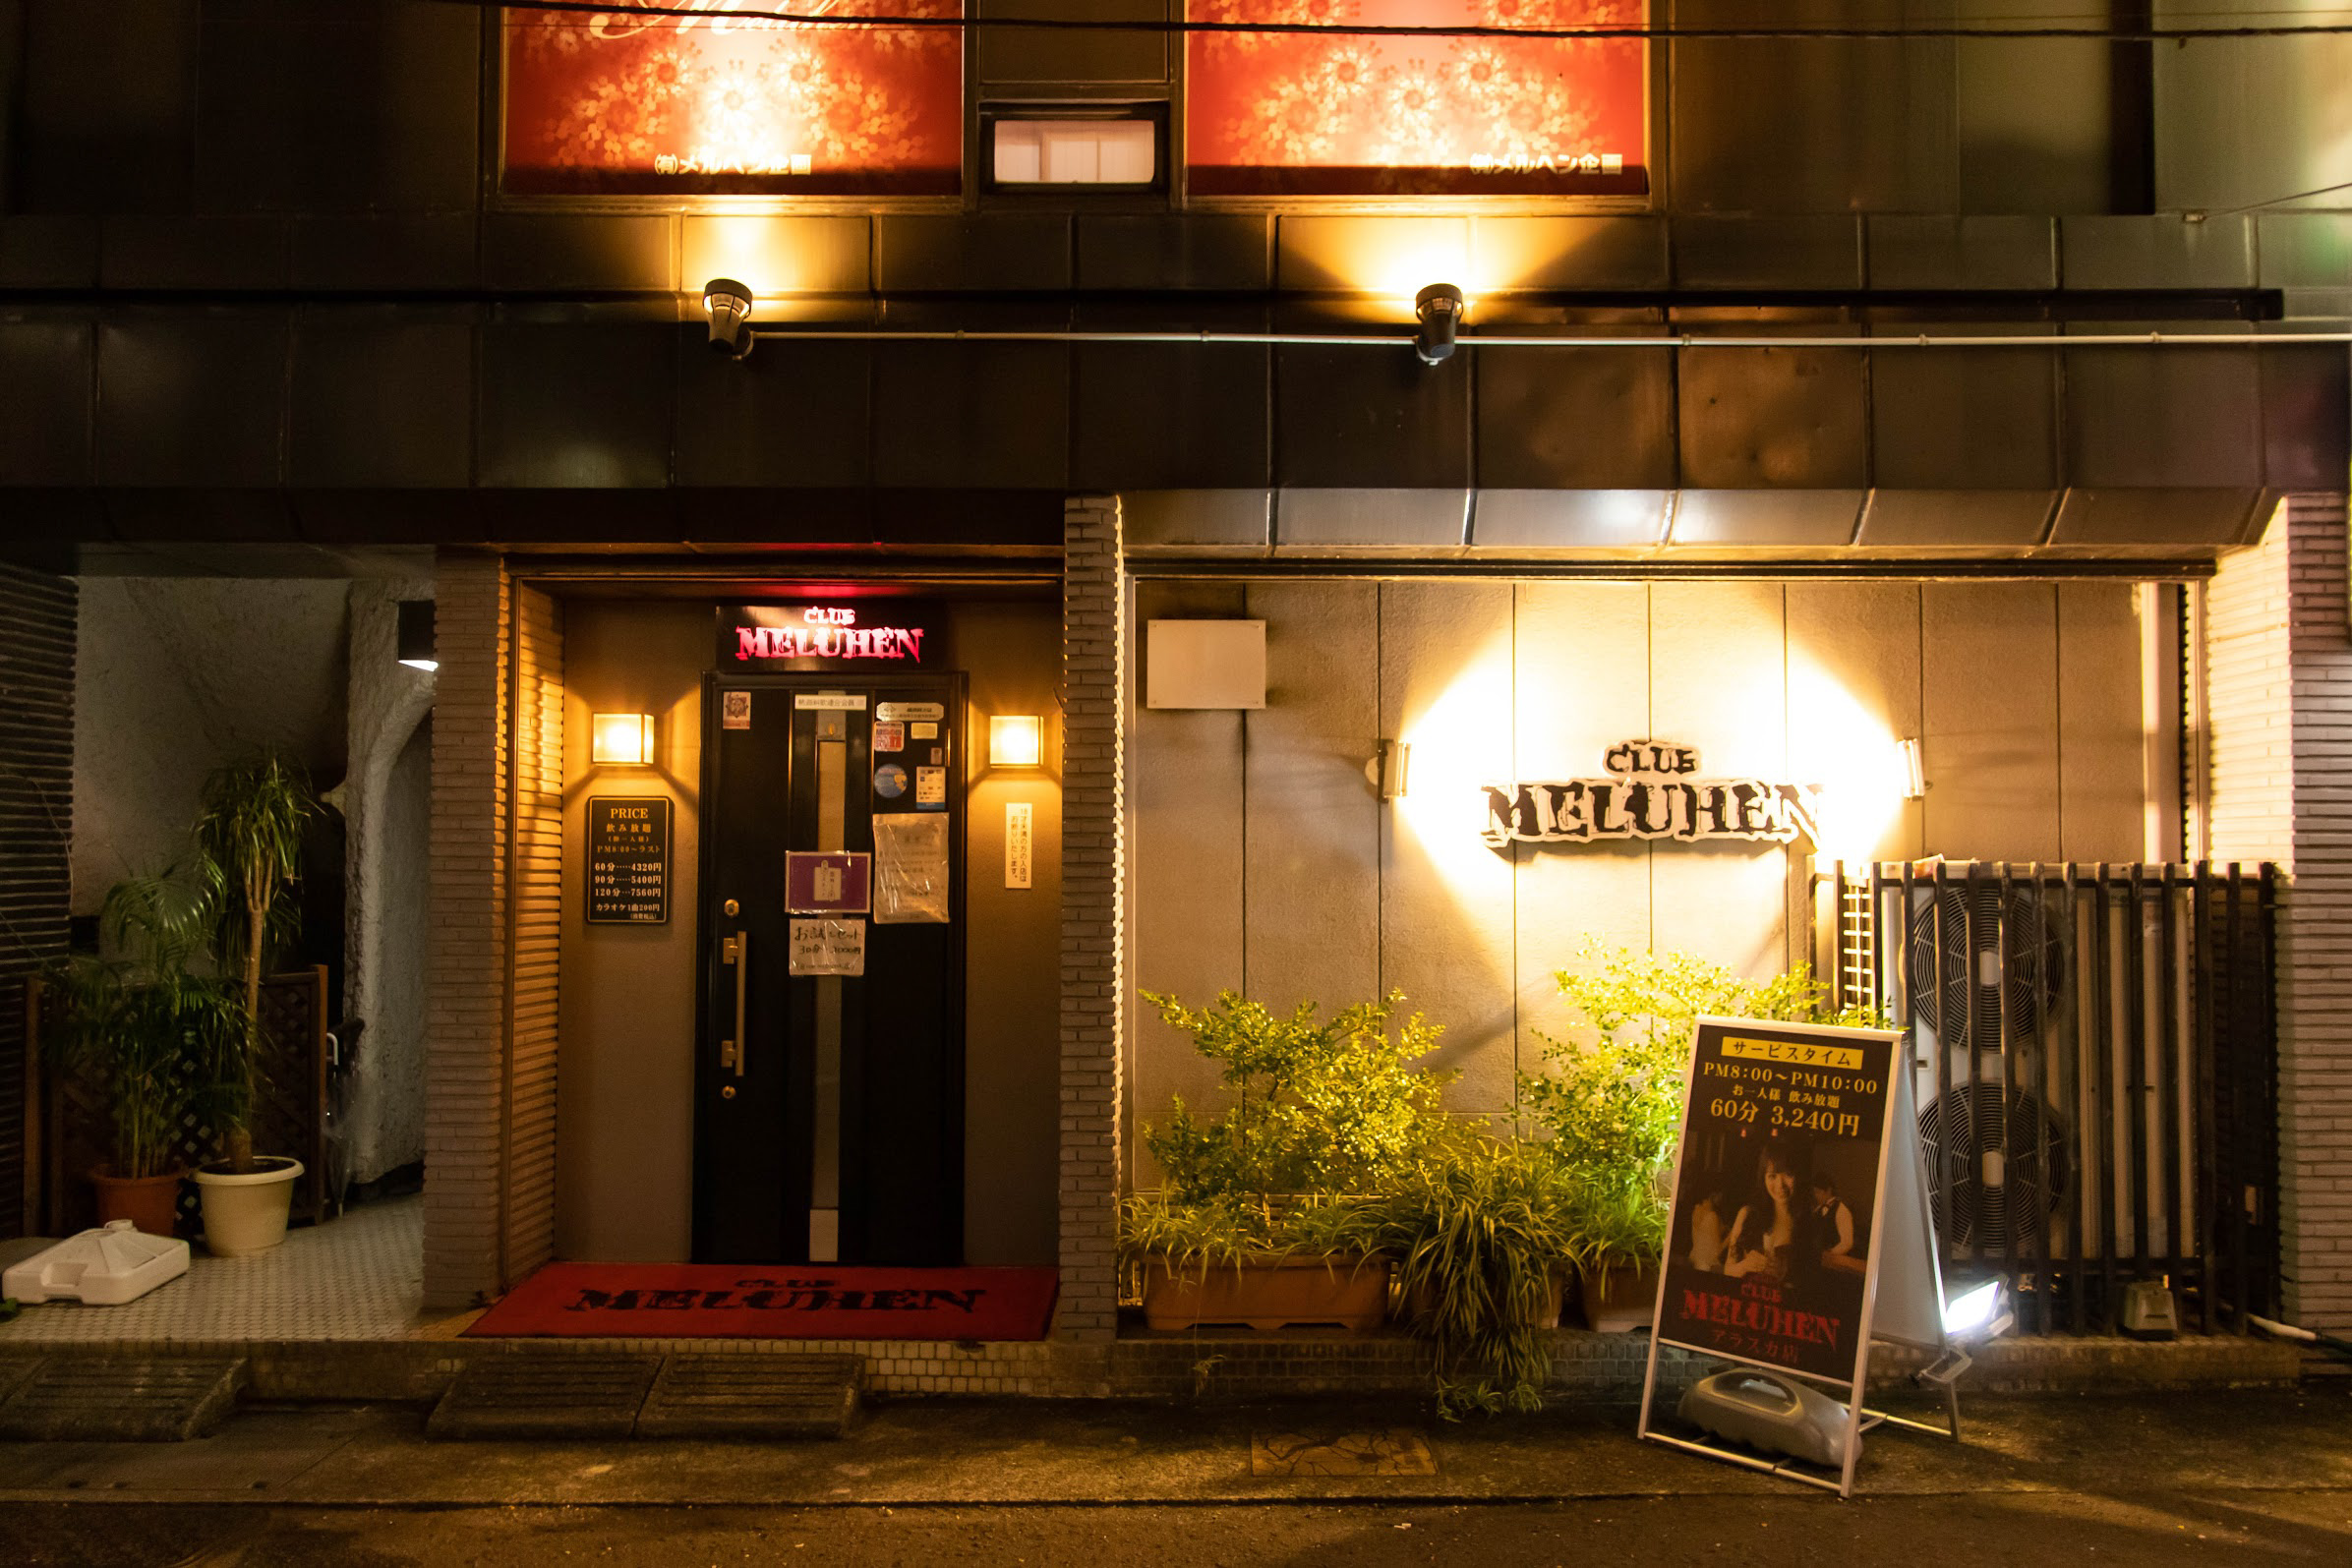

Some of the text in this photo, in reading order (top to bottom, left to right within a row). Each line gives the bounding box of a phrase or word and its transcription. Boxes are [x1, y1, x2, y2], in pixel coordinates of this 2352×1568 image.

[803, 606, 855, 625] CLUB
[735, 626, 924, 663] MELUHEN
[1606, 742, 1699, 775] CLUB
[611, 808, 648, 819] PRICE
[1481, 783, 1822, 843] MELUHEN
[1734, 1041, 1851, 1067] サービスタイム
[1733, 1084, 1841, 1109] お一人様 飲み放題
[1710, 1098, 1860, 1136] 60分 3,240円
[563, 1289, 987, 1313] MELUHEN
[1680, 1289, 1841, 1351] MELUHEN
